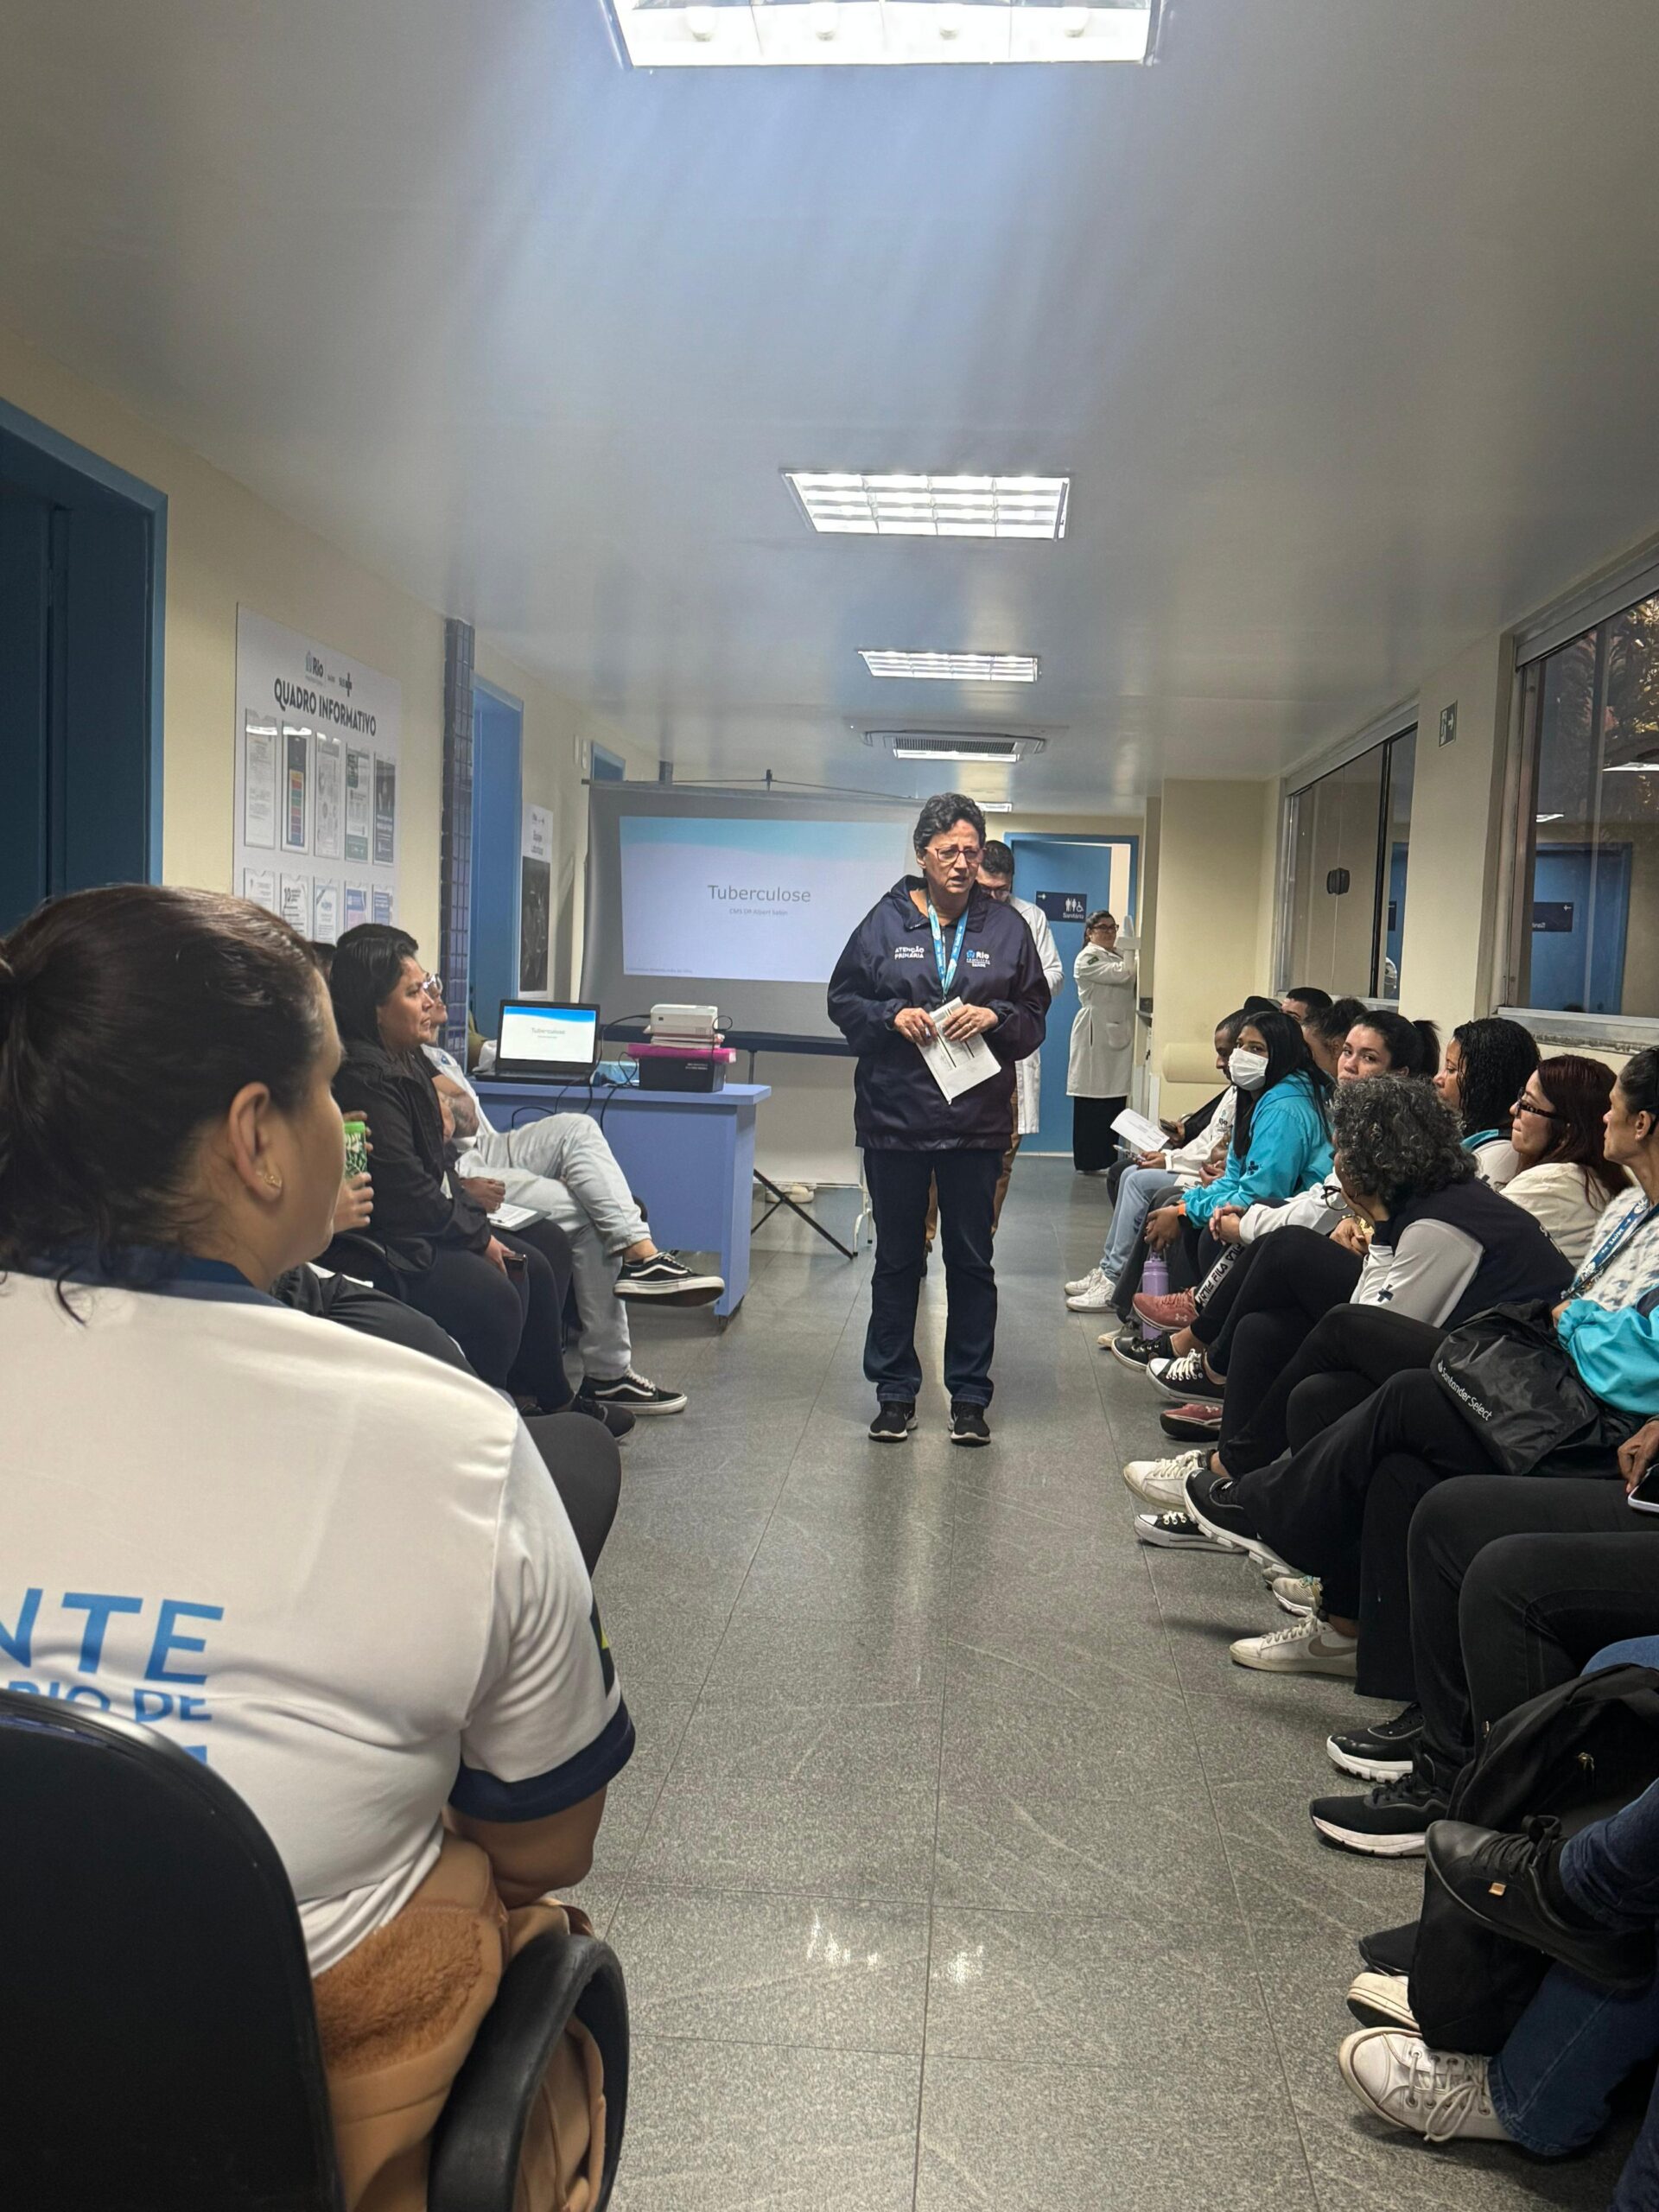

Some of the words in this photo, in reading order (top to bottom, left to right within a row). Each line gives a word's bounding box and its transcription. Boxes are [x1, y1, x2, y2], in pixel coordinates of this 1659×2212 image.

[274, 677, 317, 715] QUADRO
[319, 695, 377, 737] INFORMATIVO
[707, 884, 811, 903] Tuberculose
[976, 950, 990, 960] Rio
[1211, 1262, 1229, 1282] FILA
[1441, 1367, 1471, 1402] Santander
[1468, 1397, 1492, 1421] Select
[133, 1688, 213, 1722] DE
